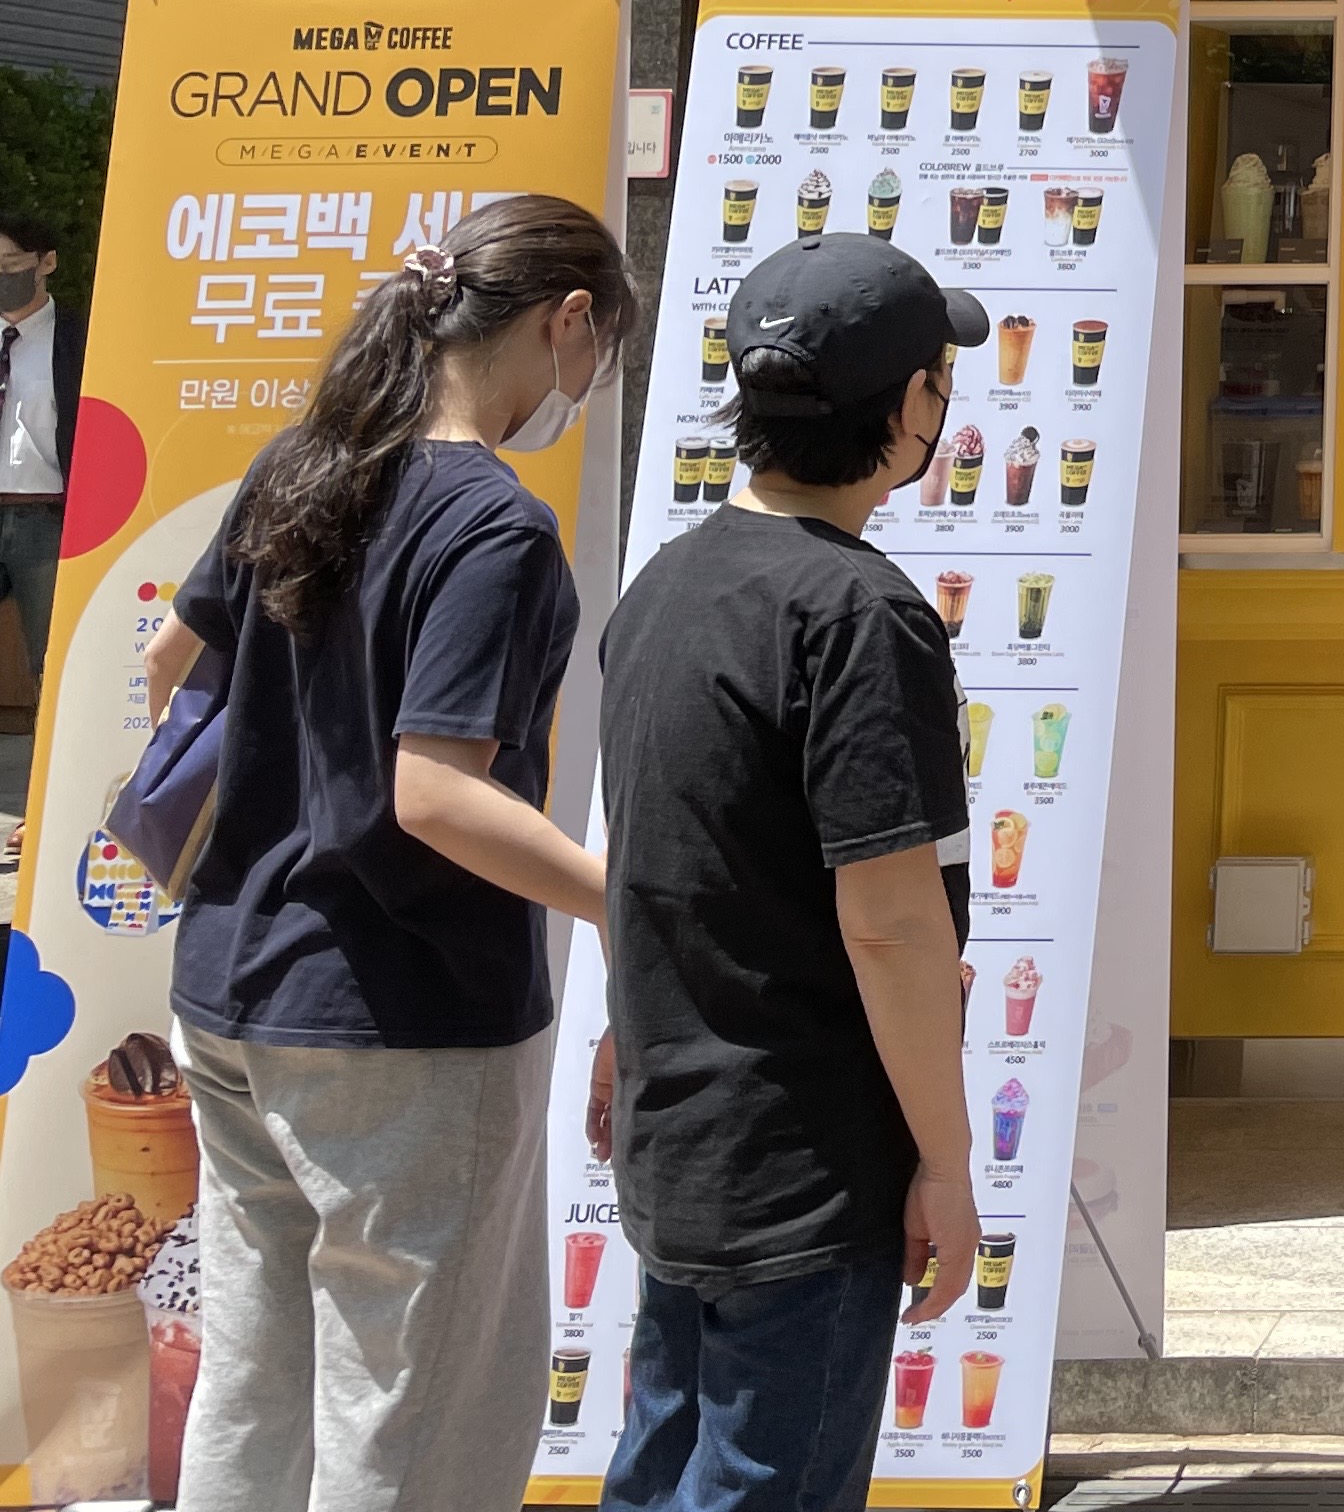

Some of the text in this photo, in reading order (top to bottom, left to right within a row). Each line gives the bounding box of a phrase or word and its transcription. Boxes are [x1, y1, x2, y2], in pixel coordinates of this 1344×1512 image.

[292, 26, 454, 51] MEGA COFFEE
[726, 33, 804, 50] COFFEE
[169, 66, 563, 118] GRAND OPEN
[724, 132, 774, 145] 아메리카노
[718, 154, 782, 165] 1500 2000
[919, 162, 972, 172] COLDBREW
[166, 190, 373, 261] 에코백
[190, 273, 325, 344] 무료
[691, 303, 716, 311] WITH
[180, 378, 239, 409] 만원
[676, 414, 699, 424] NON
[1005, 1055, 1026, 1064] 4500
[910, 1331, 931, 1340] 2500
[976, 1331, 998, 1340] 2500
[548, 1445, 570, 1456] 2500
[894, 1449, 915, 1458] 3500
[961, 1449, 983, 1458] 3500
